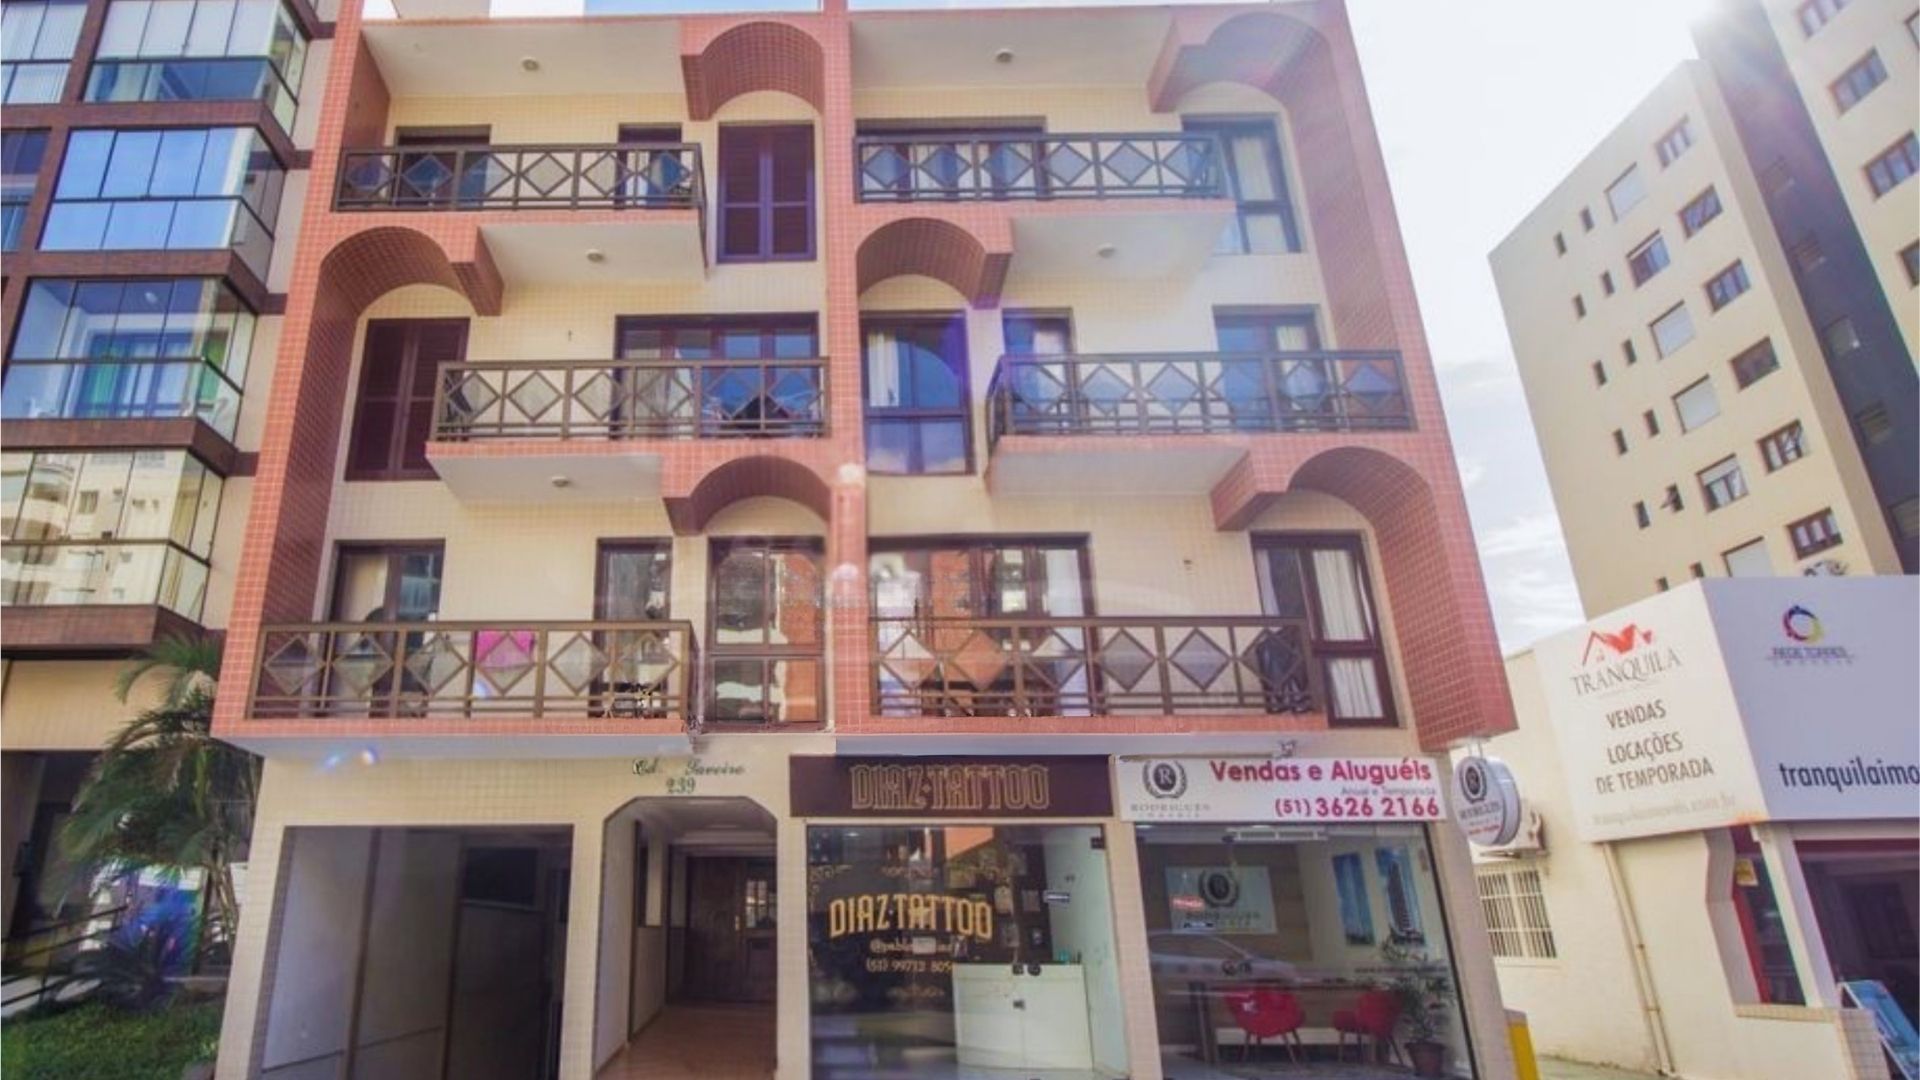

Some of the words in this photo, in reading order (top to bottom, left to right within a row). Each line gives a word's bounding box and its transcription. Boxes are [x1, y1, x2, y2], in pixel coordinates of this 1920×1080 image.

[1570, 650, 1684, 696] TRANQUILA
[1606, 699, 1667, 730] VENDAS
[1607, 731, 1684, 766] LOCAÇÕES
[1210, 760, 1301, 782] Vendas
[1308, 765, 1323, 781] e
[1596, 775, 1615, 795] DE
[1619, 756, 1715, 792] TEMPORADA
[1779, 756, 1920, 794] tranquilaimo
[1275, 799, 1312, 818] (51)
[1316, 798, 1373, 818] 3626
[1381, 798, 1439, 817] 2166
